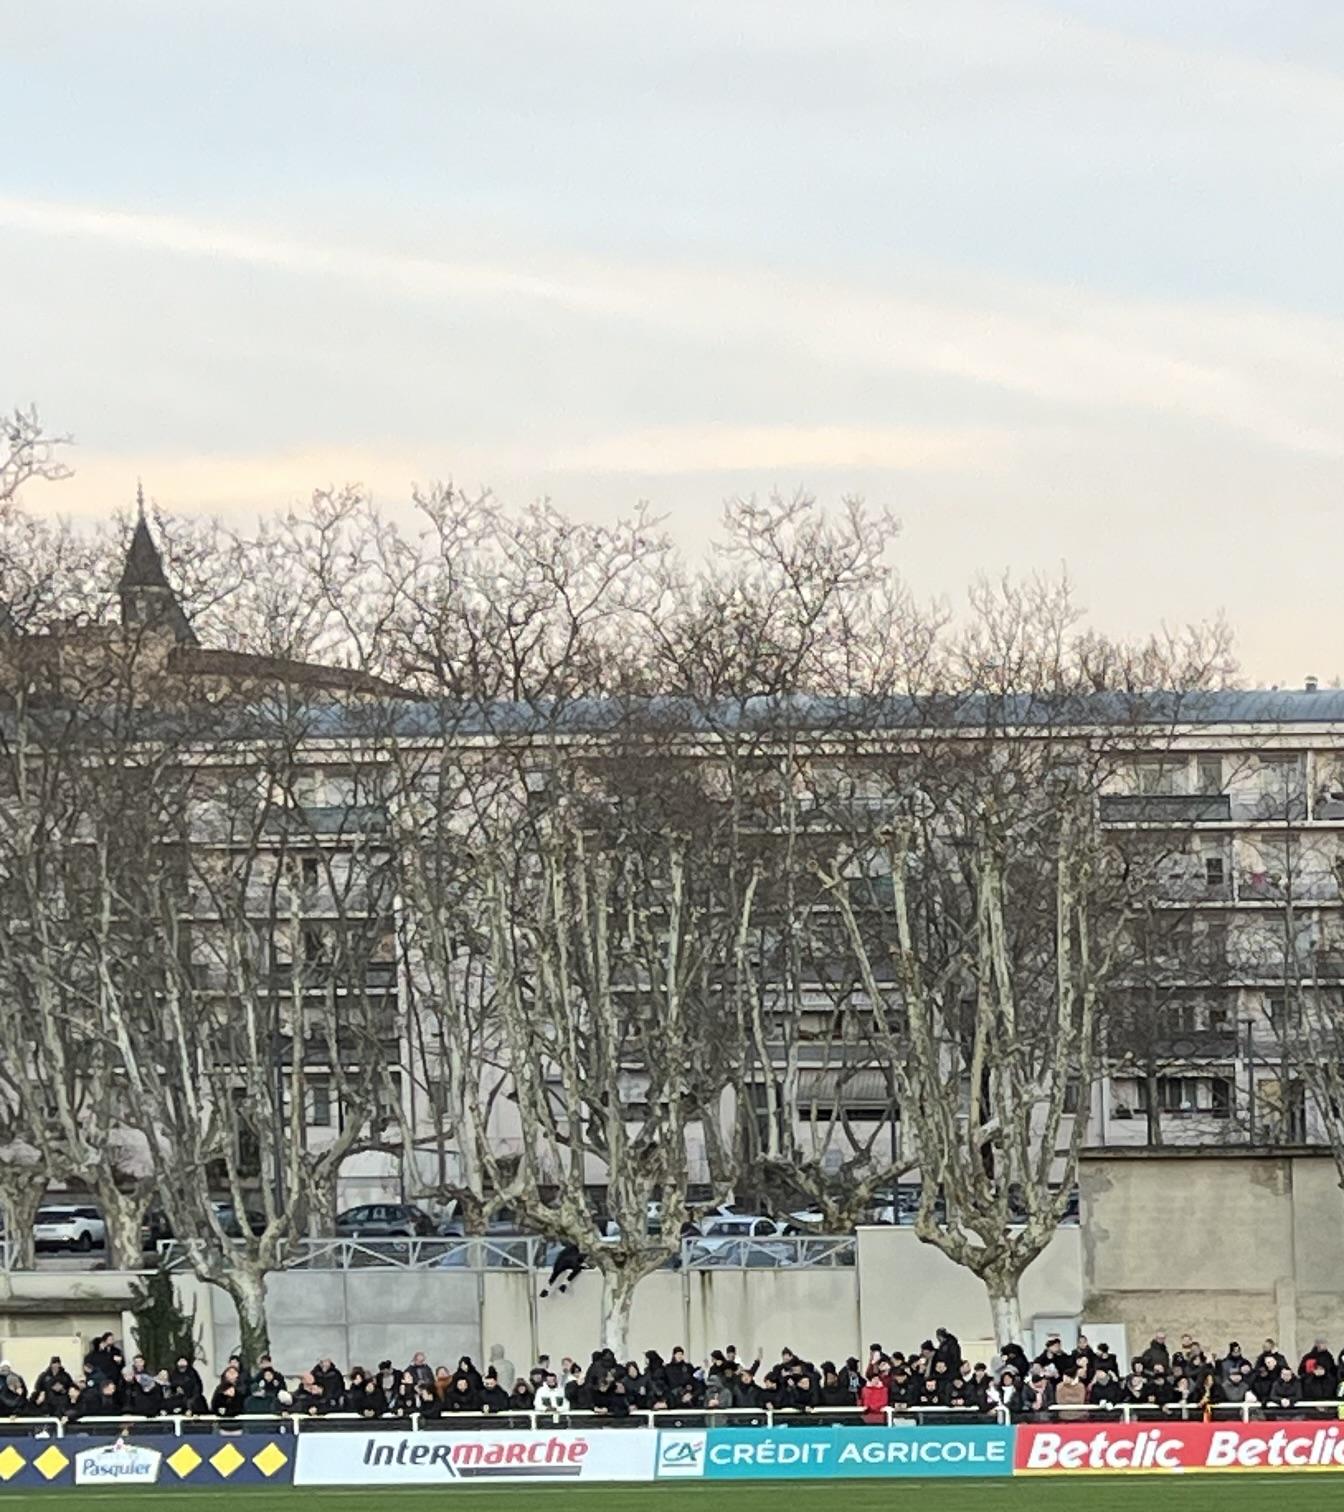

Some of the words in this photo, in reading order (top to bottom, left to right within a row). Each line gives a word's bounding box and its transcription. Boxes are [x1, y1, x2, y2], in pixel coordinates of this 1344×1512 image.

[363, 1437, 588, 1477] Intermarché
[710, 1439, 831, 1465] CRÉDIT
[839, 1440, 1005, 1464] AGRICOLE
[1027, 1429, 1184, 1468] Betclic
[82, 1458, 152, 1477] Pasquier
